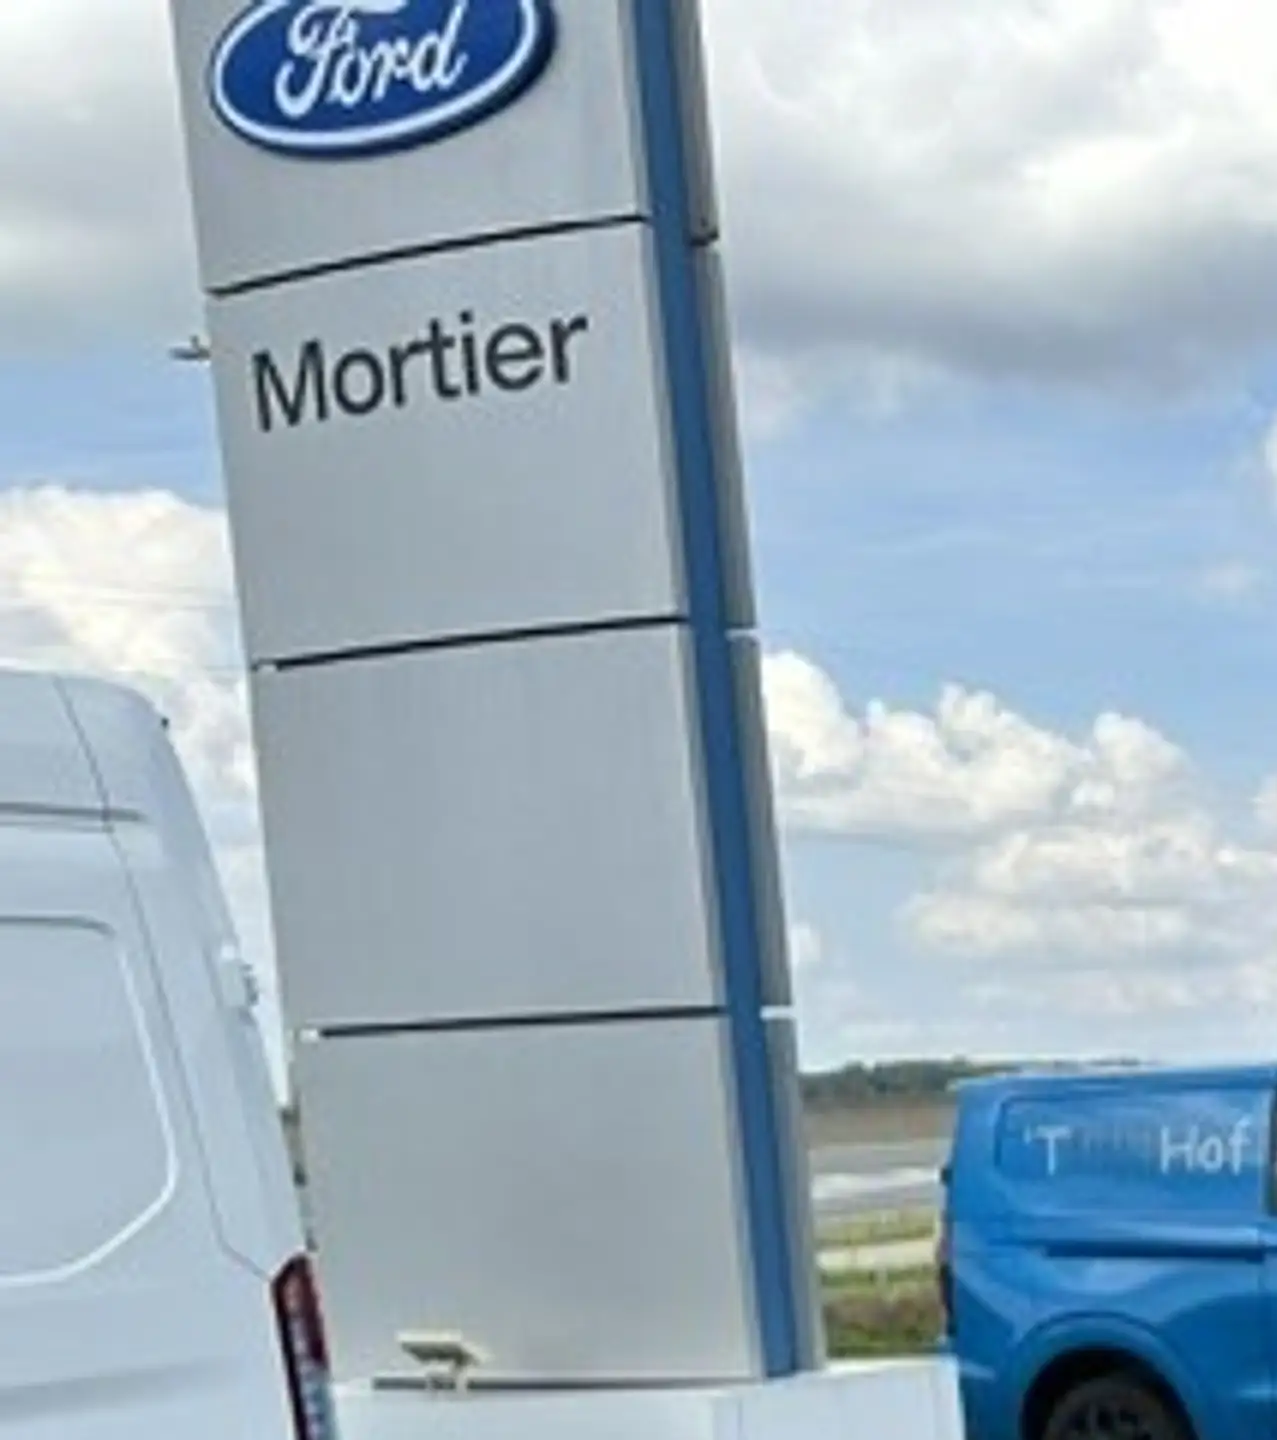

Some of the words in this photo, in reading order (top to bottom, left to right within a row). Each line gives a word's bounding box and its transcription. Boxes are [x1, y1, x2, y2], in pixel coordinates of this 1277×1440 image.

[274, 0, 469, 117] Ford
[251, 308, 590, 432] Mortier
[1159, 1115, 1251, 1177] Hof
